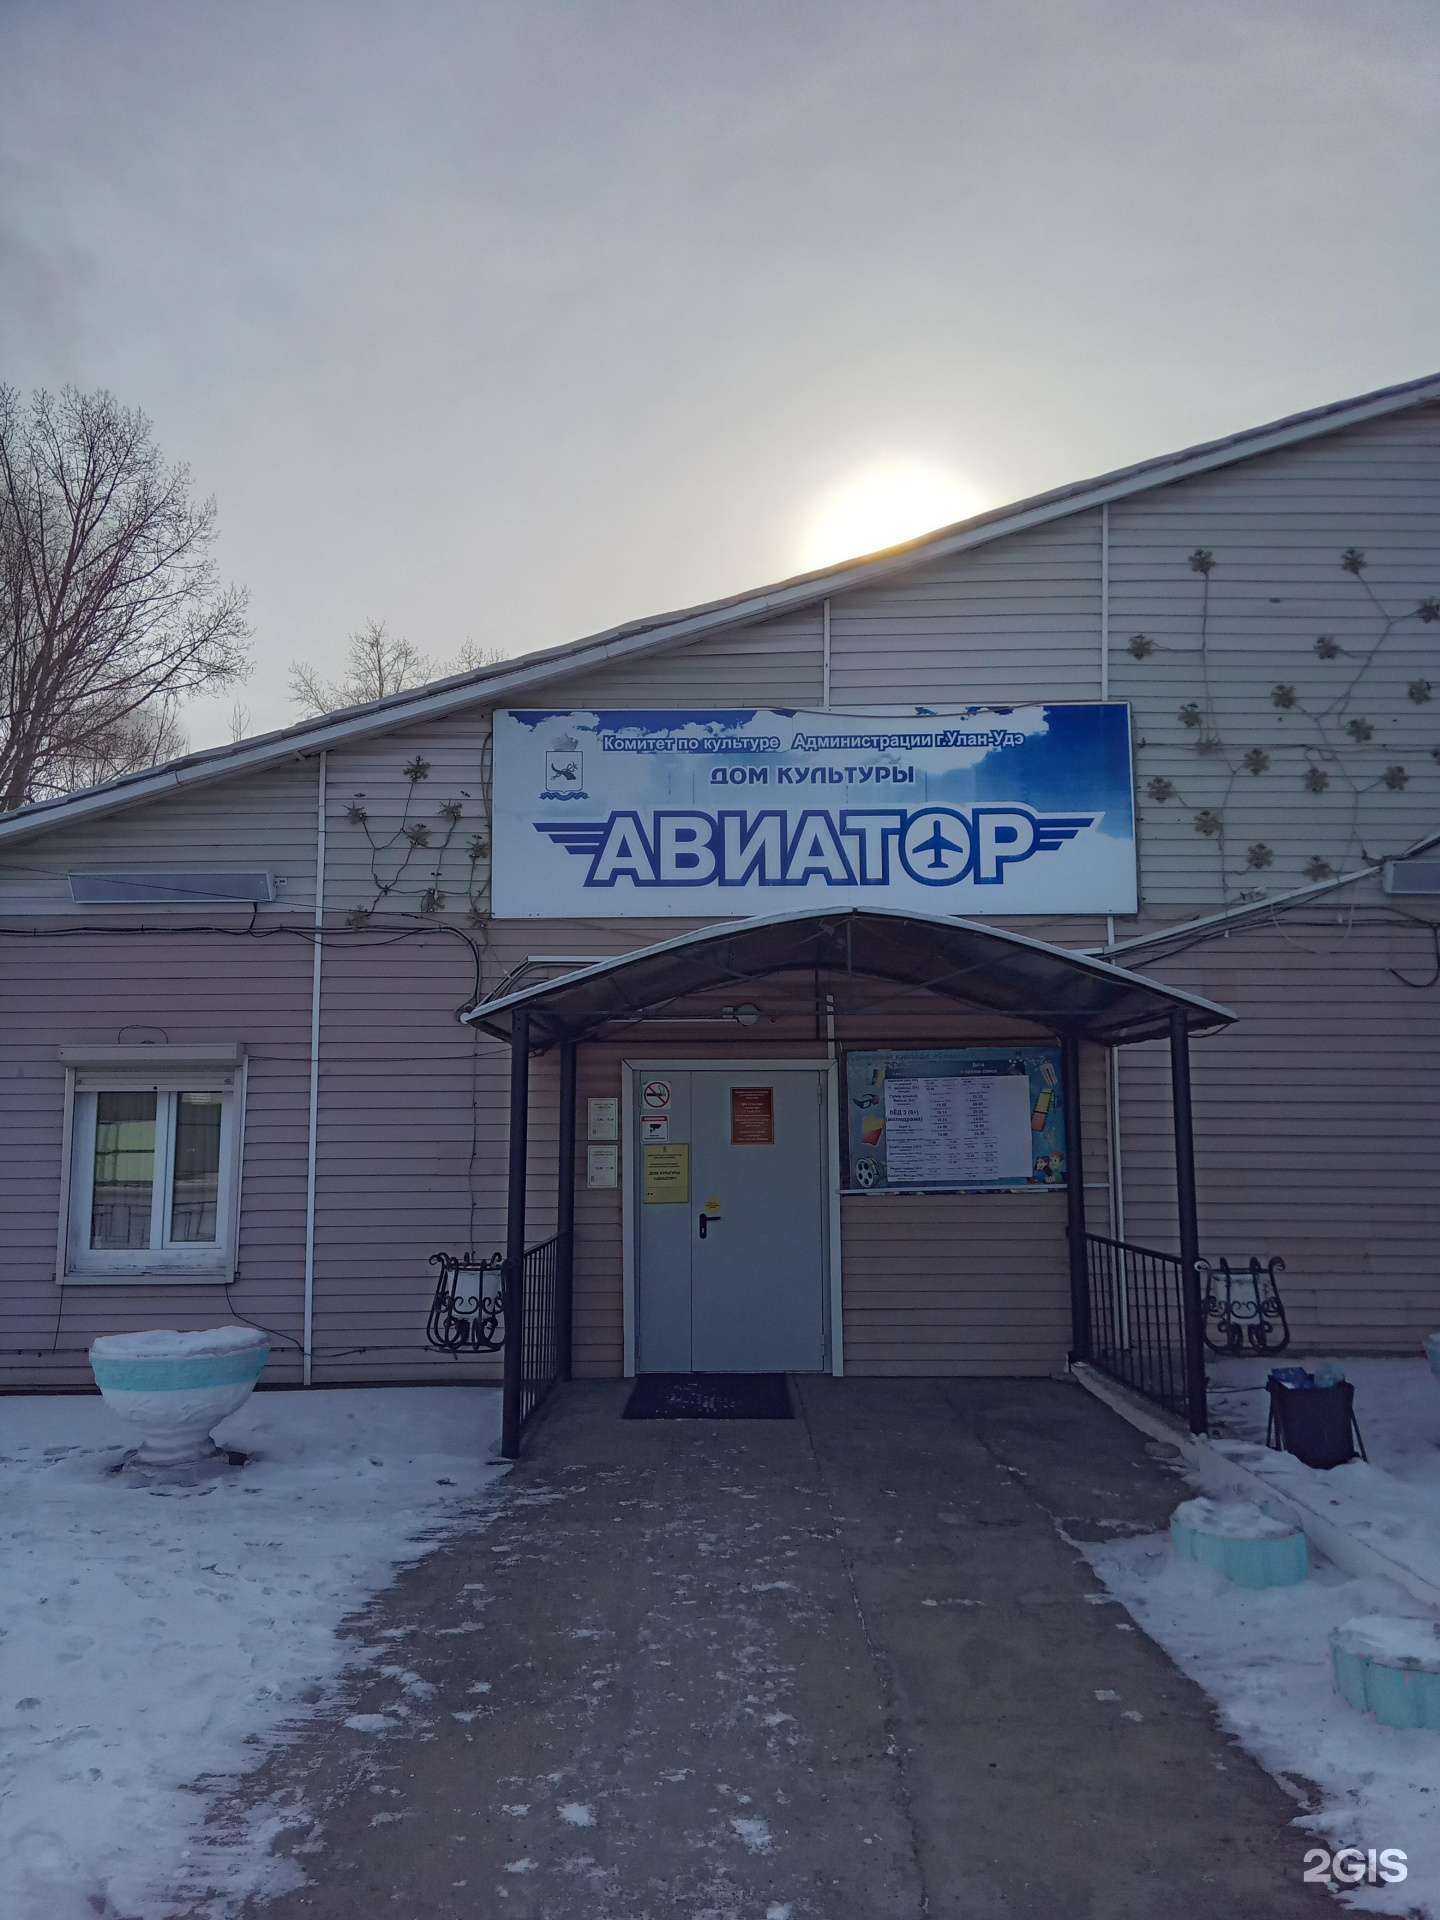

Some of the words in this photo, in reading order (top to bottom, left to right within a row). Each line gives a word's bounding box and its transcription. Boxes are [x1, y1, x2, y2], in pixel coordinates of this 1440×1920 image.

[603, 735, 675, 751] Комитет
[677, 737, 699, 750] по
[704, 736, 781, 752] культуре
[792, 733, 932, 750] Администрации
[710, 767, 768, 785] ДОМ
[777, 765, 914, 784] КУЛЬТУРЫ
[583, 806, 1038, 888] АВИАТОР
